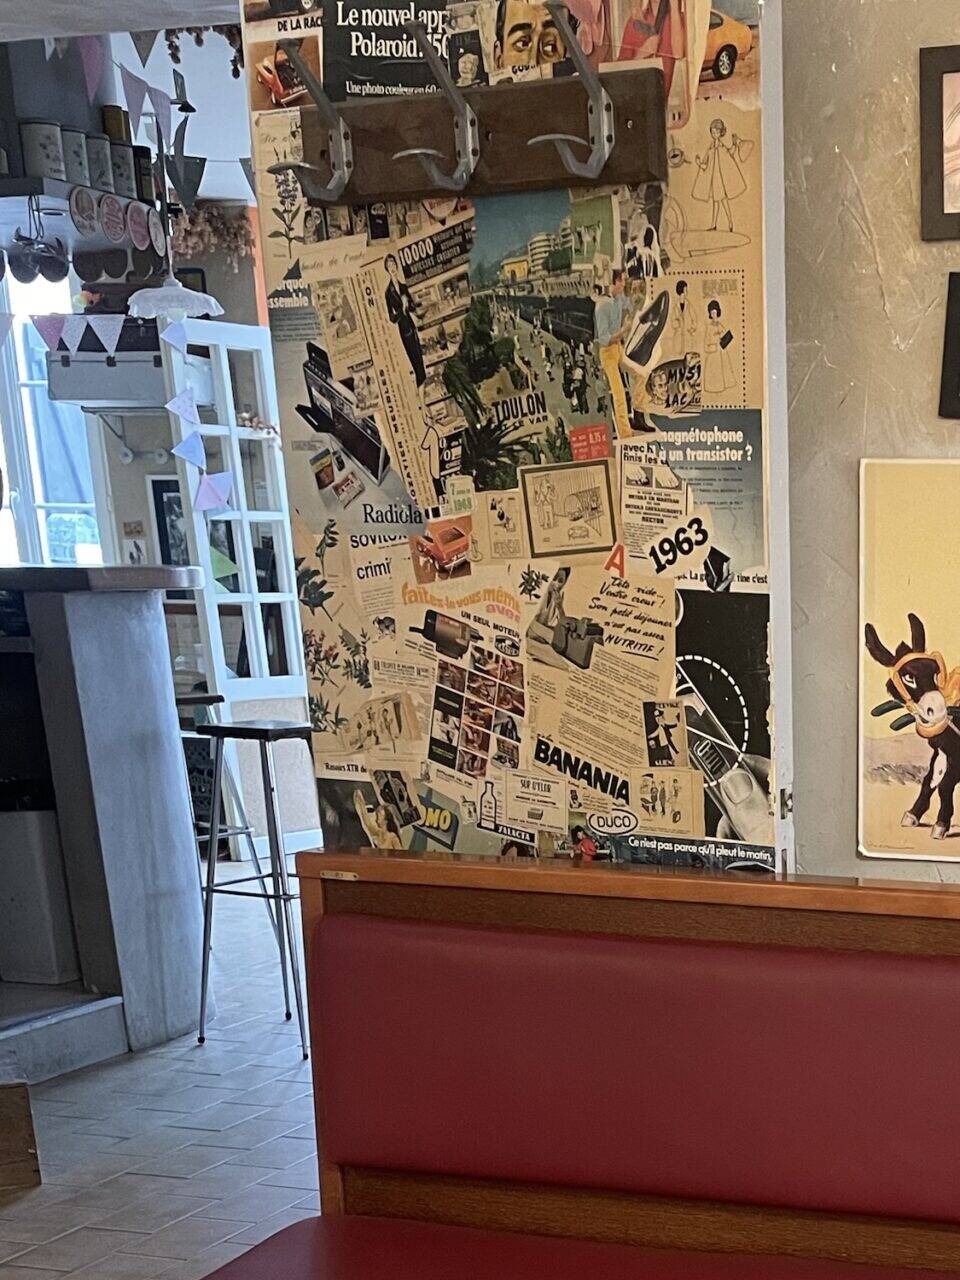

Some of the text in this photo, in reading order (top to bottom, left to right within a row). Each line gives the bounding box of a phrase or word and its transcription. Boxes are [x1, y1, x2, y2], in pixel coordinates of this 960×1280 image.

[336, 1, 359, 26] Le
[361, 2, 415, 26] nouvel
[277, 20, 288, 32] DE
[290, 18, 302, 30] LA
[346, 80, 361, 93] Une
[361, 82, 384, 96] photo
[491, 391, 547, 423] TOULON
[528, 415, 548, 426] VAR
[623, 444, 645, 453] avec
[669, 450, 684, 462] un
[686, 445, 743, 462] transistor
[745, 443, 753, 462] ?
[623, 452, 643, 463] finis
[645, 453, 658, 465] les
[362, 503, 424, 526] Radiola
[648, 517, 709, 574] 1963
[604, 544, 625, 579] A
[599, 581, 629, 600] Ventre
[588, 596, 608, 611] Son
[610, 607, 633, 617] petit
[461, 610, 472, 621] UN
[473, 614, 491, 629] SEUL
[624, 625, 641, 634] pas
[604, 634, 656, 654] NUTRITIF
[534, 737, 630, 806] BANANIA
[596, 814, 632, 828] DUCO
[628, 836, 773, 862] Ce n'est pas parce qu'il pleut le matin,
